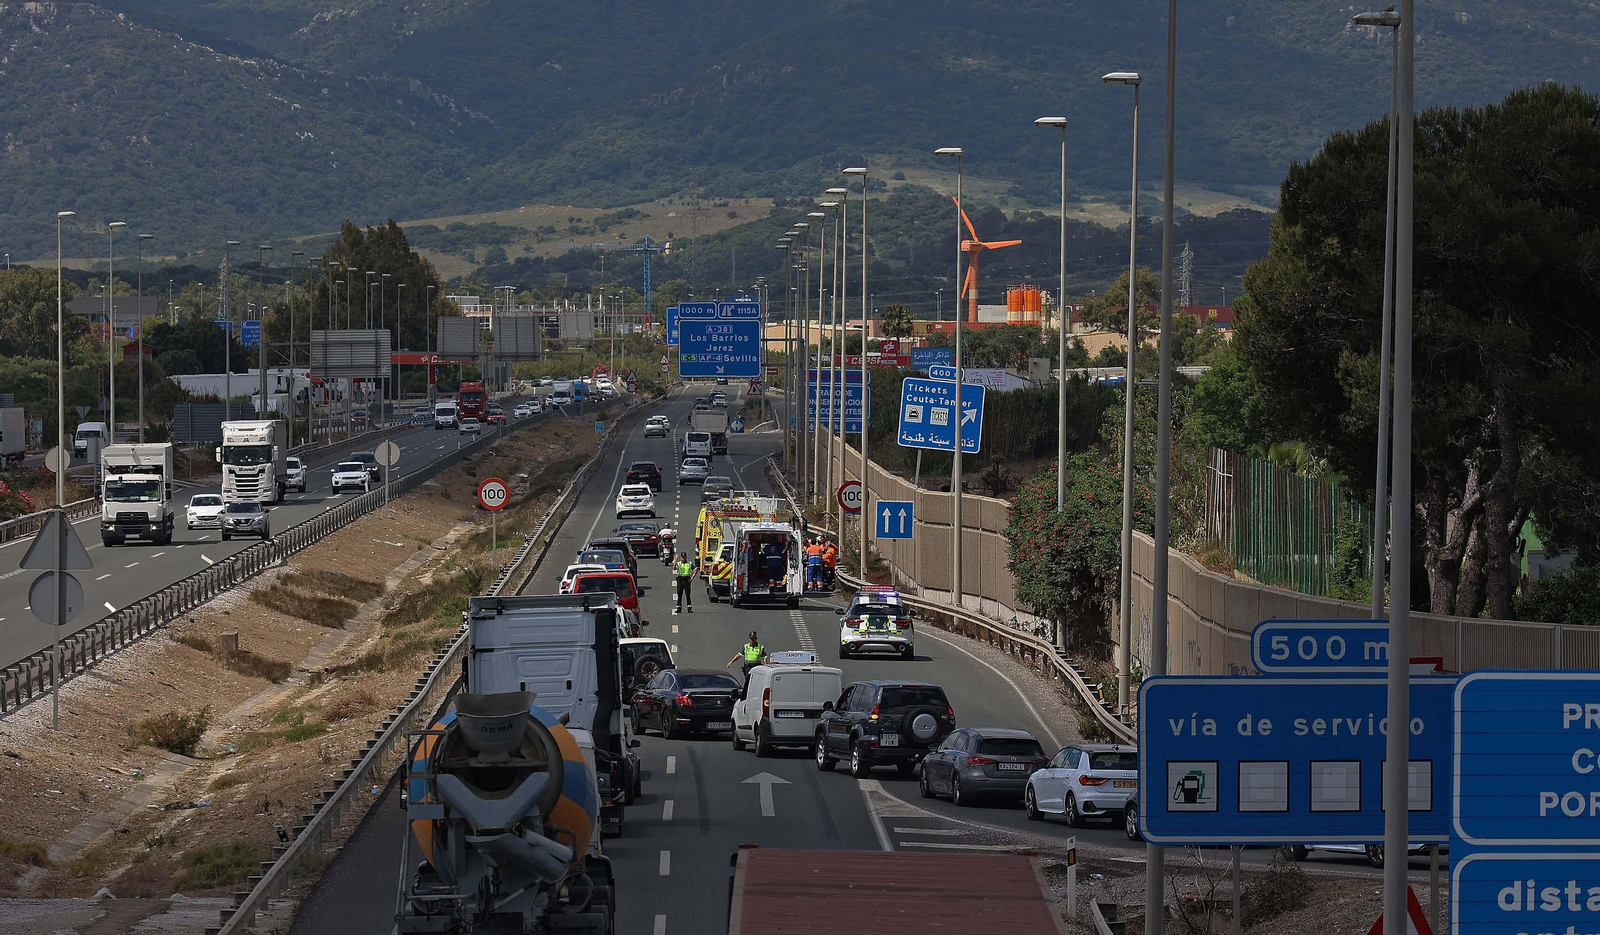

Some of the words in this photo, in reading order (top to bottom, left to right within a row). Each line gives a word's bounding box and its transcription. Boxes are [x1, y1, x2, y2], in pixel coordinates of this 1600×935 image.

[737, 307, 757, 315] 1115A
[690, 334, 707, 342] Los
[711, 334, 749, 342] Barrios
[706, 344, 734, 352] Jerez
[723, 354, 757, 362] Sevilla
[932, 369, 951, 377] 400
[908, 383, 948, 395] Tickets
[906, 394, 972, 408] Ceuta-Taner
[482, 488, 505, 500] 100
[1270, 635, 1346, 661] 500
[1363, 641, 1389, 661] m
[1168, 711, 1218, 737] vía
[1237, 713, 1273, 737] de
[1293, 712, 1425, 737] servico
[1571, 747, 1600, 775] C
[1496, 878, 1600, 912] dista
